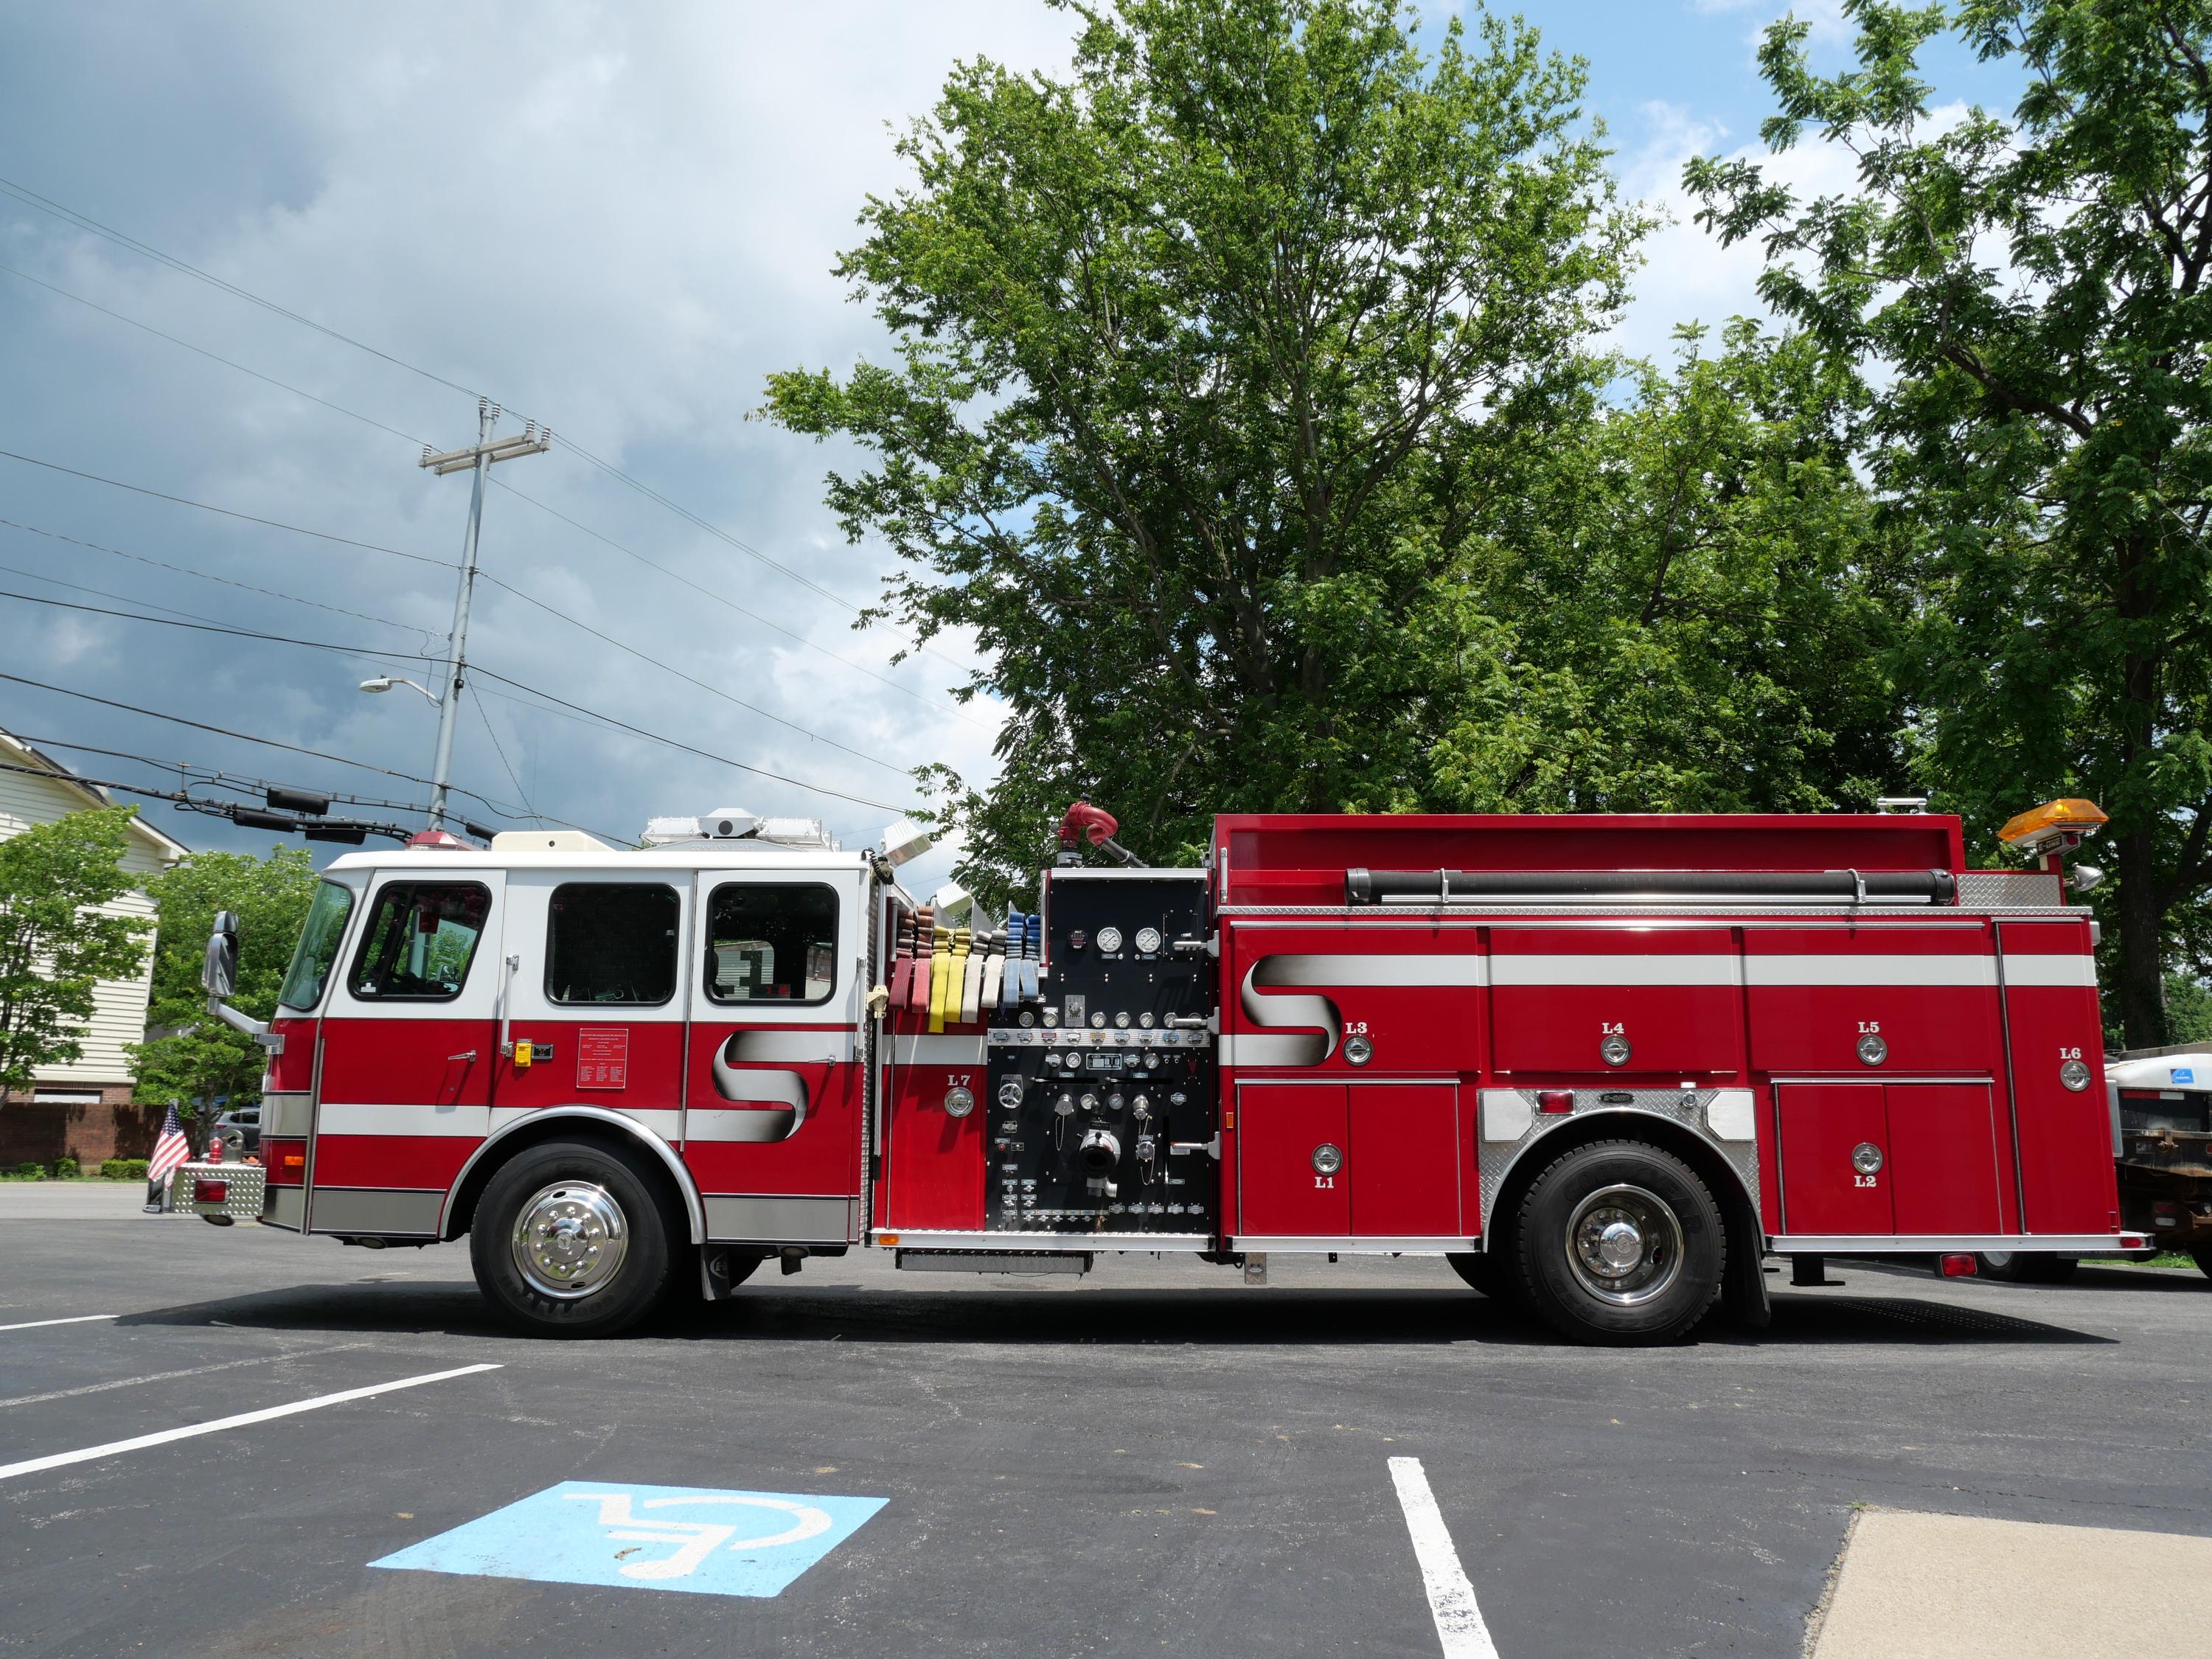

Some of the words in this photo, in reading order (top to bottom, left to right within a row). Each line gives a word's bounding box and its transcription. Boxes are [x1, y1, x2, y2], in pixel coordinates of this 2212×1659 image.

[691, 844, 726, 852] COMMAND
[2038, 839, 2061, 851] E-ONE
[1346, 1022, 1367, 1034] L3
[1602, 1023, 1625, 1034] L4
[1858, 1022, 1879, 1034] L5
[2060, 1048, 2081, 1059] L6
[947, 1074, 970, 1086] L7
[1315, 1177, 1334, 1189] L1
[1854, 1176, 1876, 1188] L2
[1563, 1161, 1702, 1233] GOODYEAR
